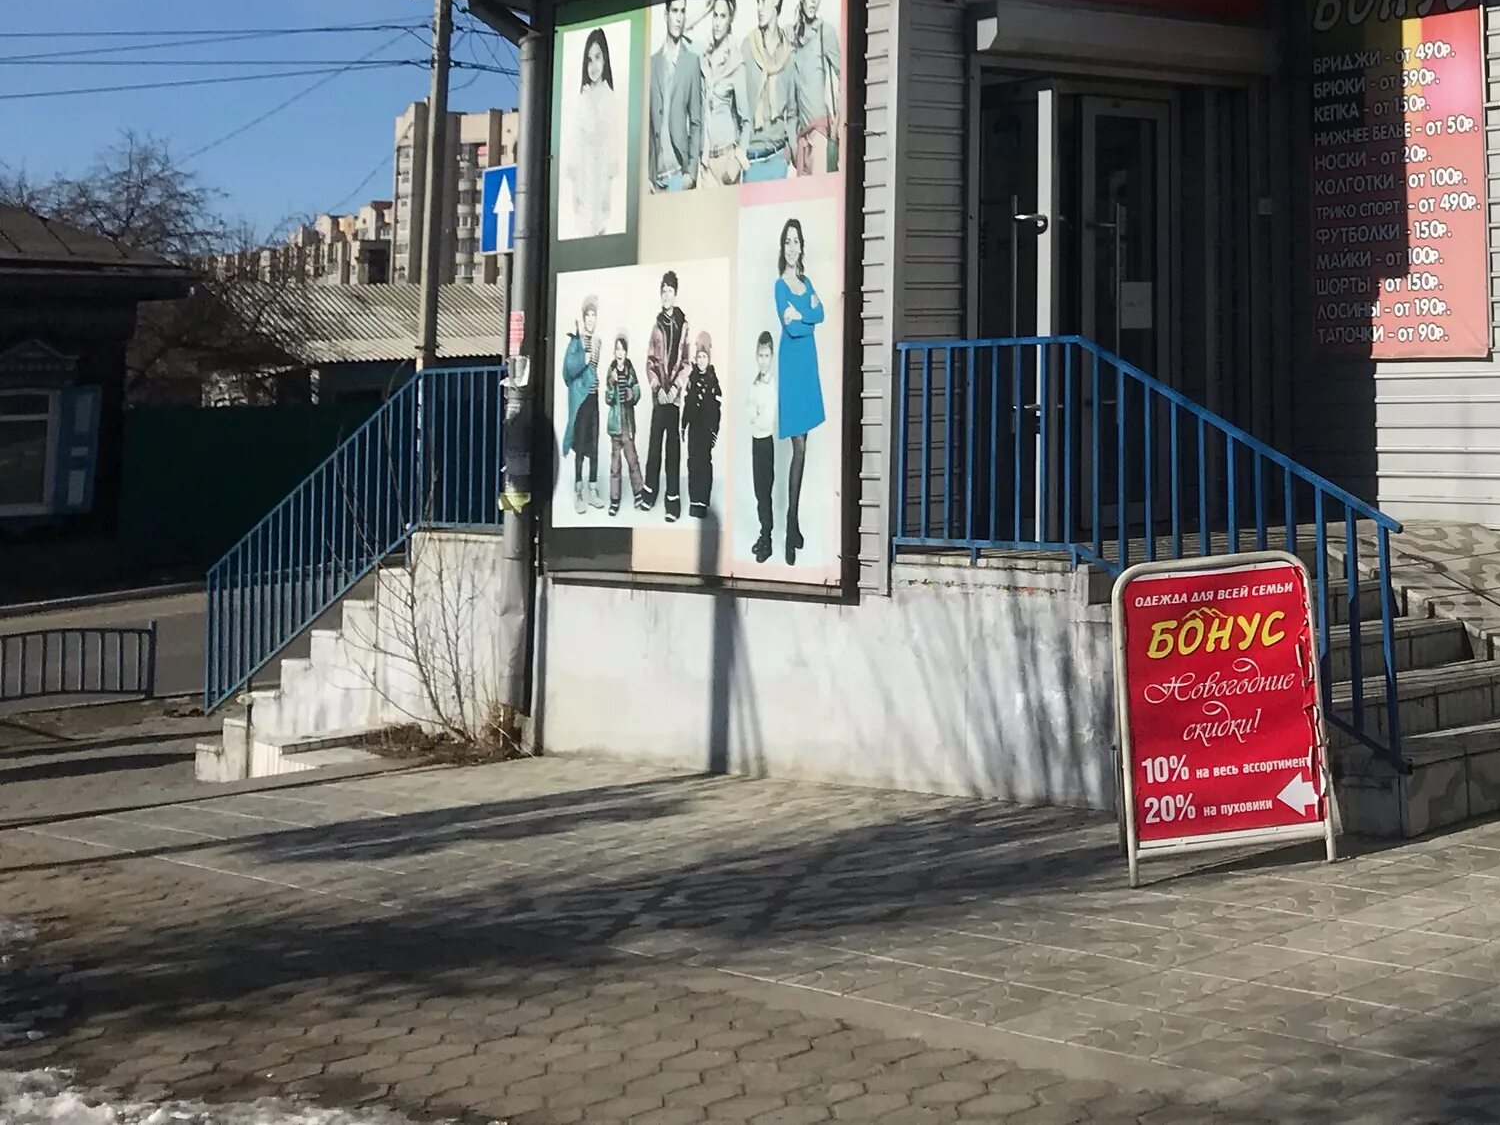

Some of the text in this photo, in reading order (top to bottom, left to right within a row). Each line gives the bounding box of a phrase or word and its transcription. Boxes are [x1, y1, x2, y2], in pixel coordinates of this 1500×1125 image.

[1313, 49, 1381, 75] БРИДЖИ
[1313, 77, 1366, 99] БРЮКИ
[1313, 102, 1360, 123] КЕПКА
[1313, 128, 1370, 147] НИЖНЕЕ
[1372, 121, 1412, 140] БЕЛЬЕ
[1314, 152, 1367, 172] НОСКИ
[1314, 174, 1395, 196] КОЛГОТКИ
[1316, 204, 1357, 220] ТРИКО
[1315, 223, 1401, 246] ФУТБОЛКИ
[1316, 248, 1372, 270] МАЙКИ
[1316, 277, 1371, 296] ШОРТЫ
[1317, 300, 1380, 320] ЛОСИНЫ
[1318, 325, 1384, 345] ТАПОЧКИ
[1135, 582, 1293, 607] ОДЕЖДА ДЛЯ ВСЕЙ СЕМЬИ
[1147, 610, 1285, 659] БОНУС
[1143, 657, 1295, 704] Новогодние
[1183, 700, 1261, 746] скидки!
[1141, 754, 1310, 784] 10% на весь ассортимент
[1144, 793, 1272, 823] 20% на пуховики
